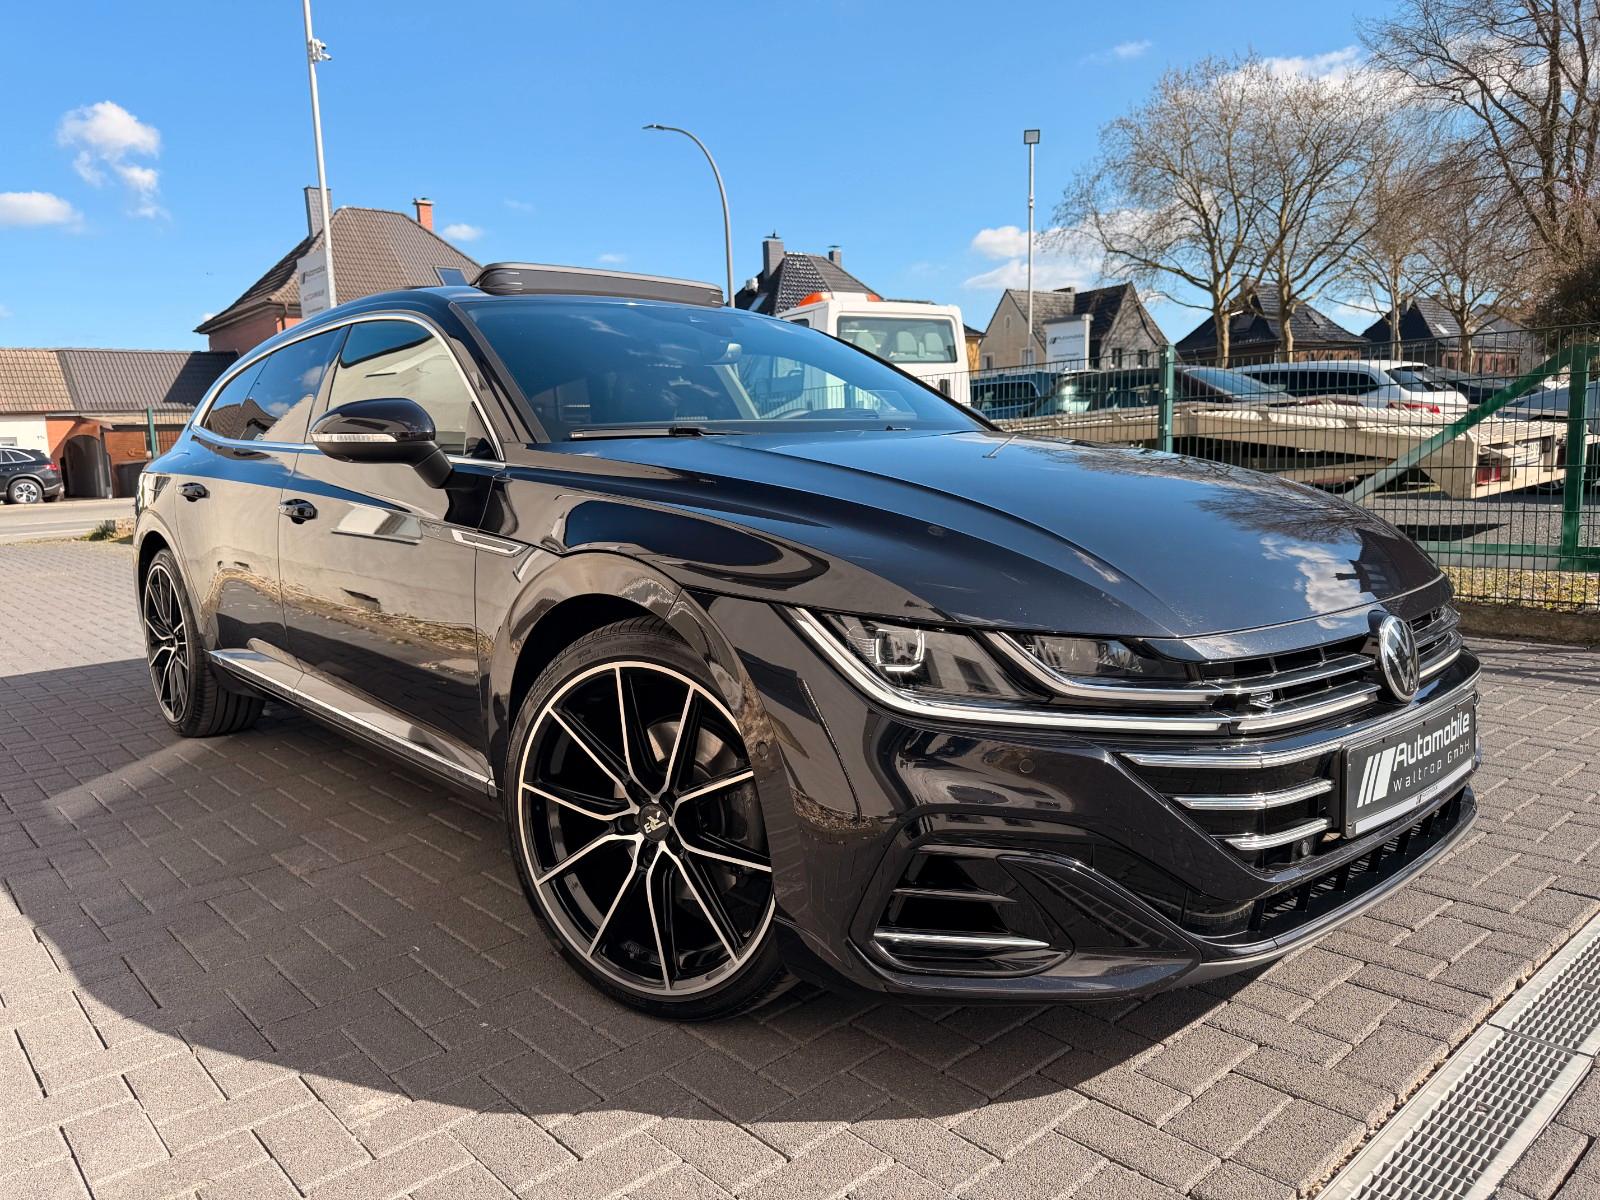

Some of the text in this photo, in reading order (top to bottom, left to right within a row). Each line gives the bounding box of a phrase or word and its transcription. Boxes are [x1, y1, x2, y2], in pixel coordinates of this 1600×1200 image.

[1393, 712, 1470, 771] Automobile
[1393, 740, 1470, 792] Waltrop GmbH
